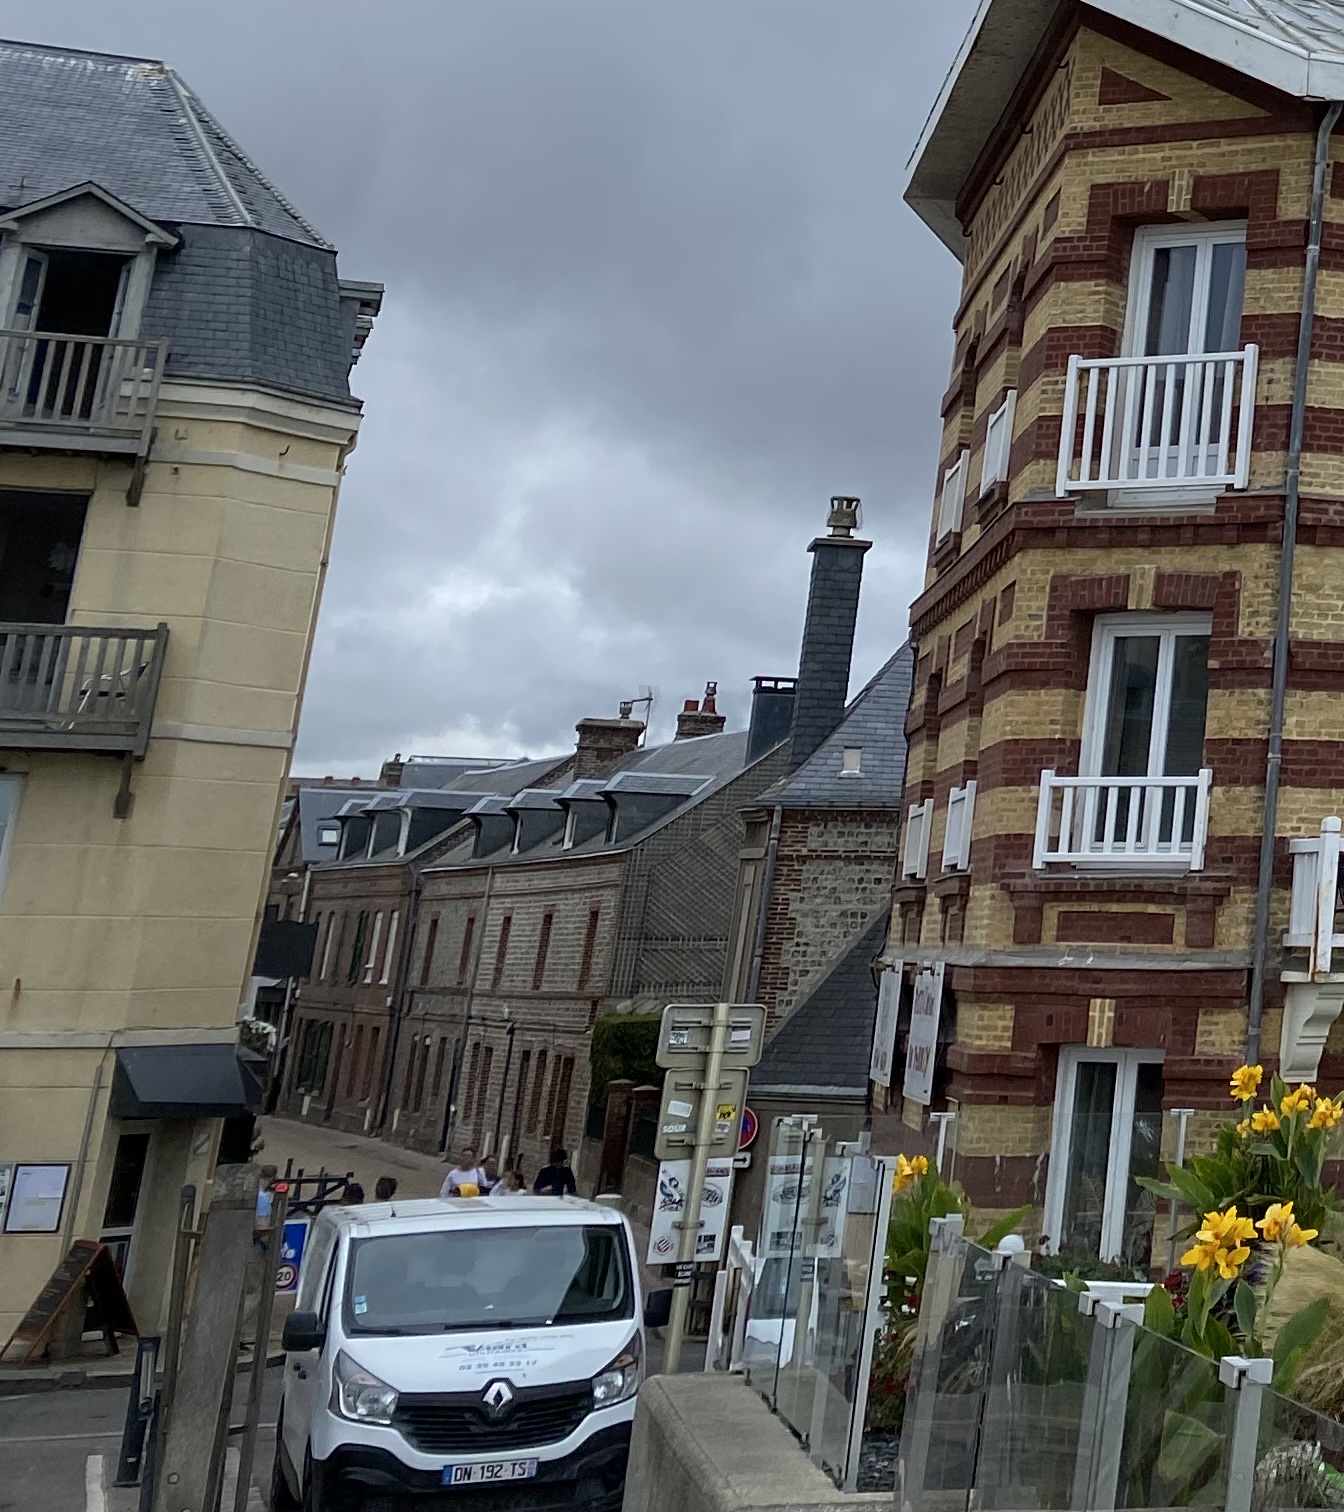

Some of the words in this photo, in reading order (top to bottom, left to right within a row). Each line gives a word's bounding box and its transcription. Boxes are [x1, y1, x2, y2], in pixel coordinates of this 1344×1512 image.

[276, 1271, 292, 1282] 20
[480, 1464, 503, 1480] 192
[511, 1462, 527, 1477] TS
